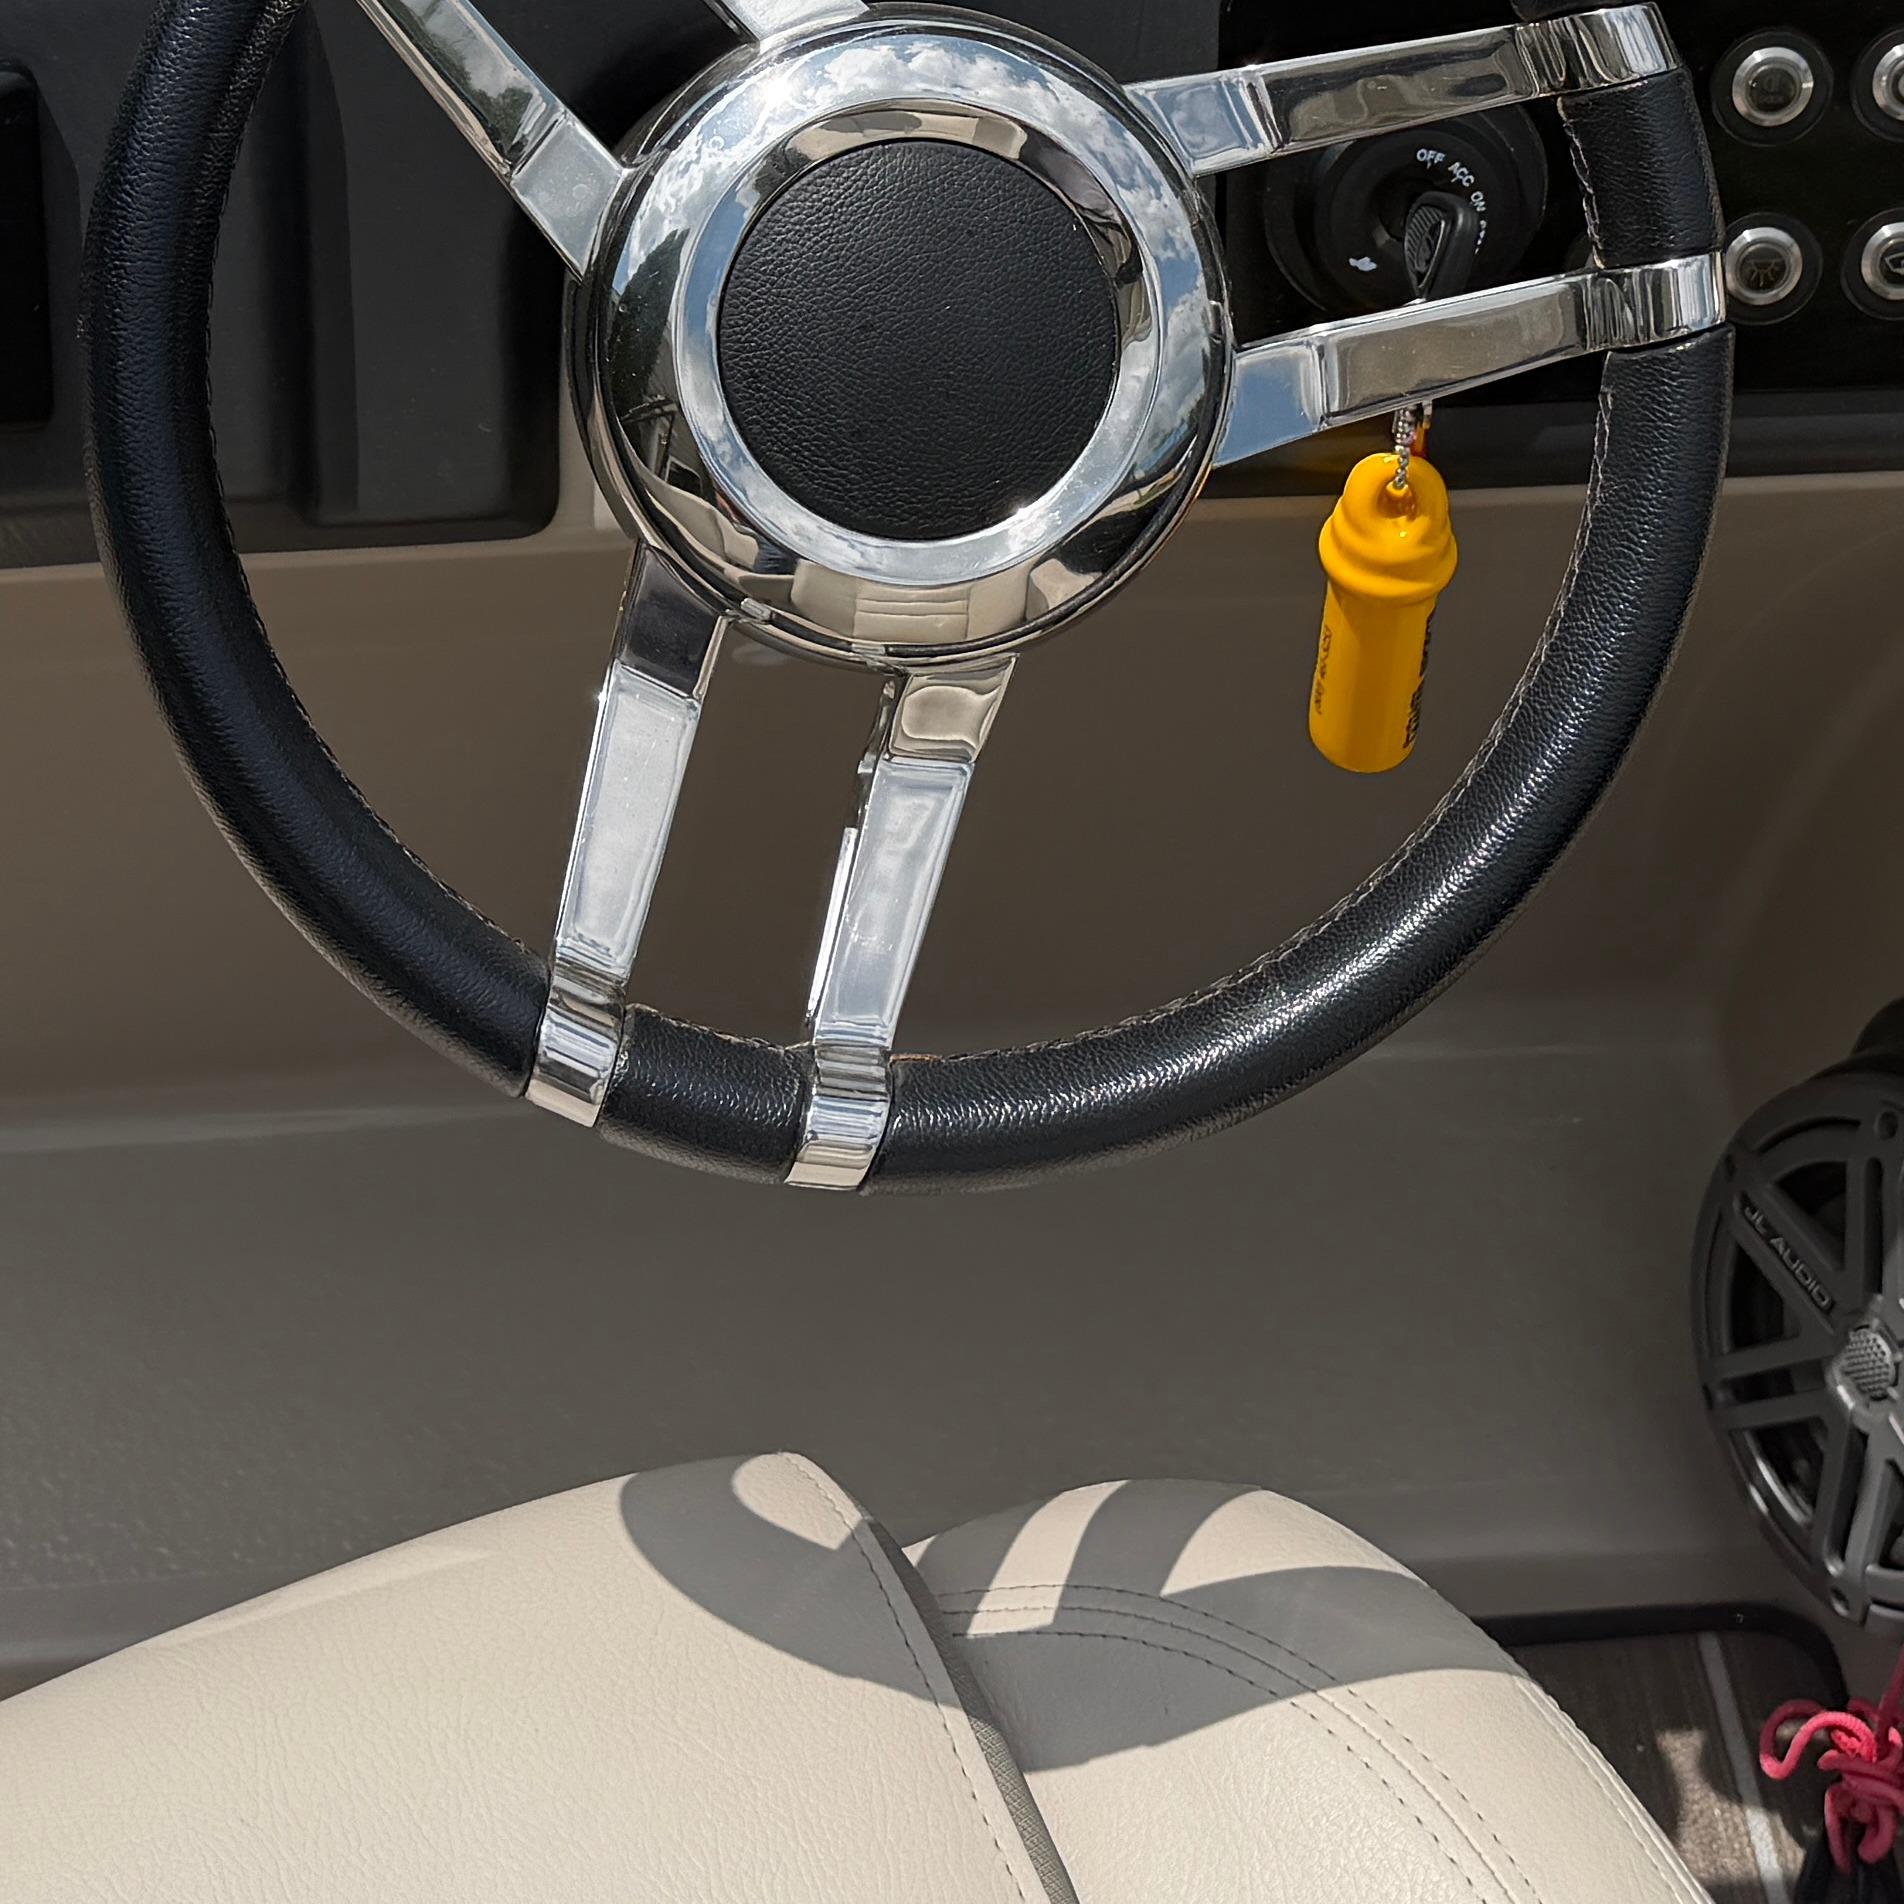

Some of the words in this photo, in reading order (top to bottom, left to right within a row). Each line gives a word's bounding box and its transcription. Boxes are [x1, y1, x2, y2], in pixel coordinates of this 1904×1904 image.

[1416, 148, 1445, 164] OFF
[1448, 162, 1474, 187] ACC
[1470, 191, 1486, 212] ON
[1770, 1237, 1833, 1308] AUDIO
